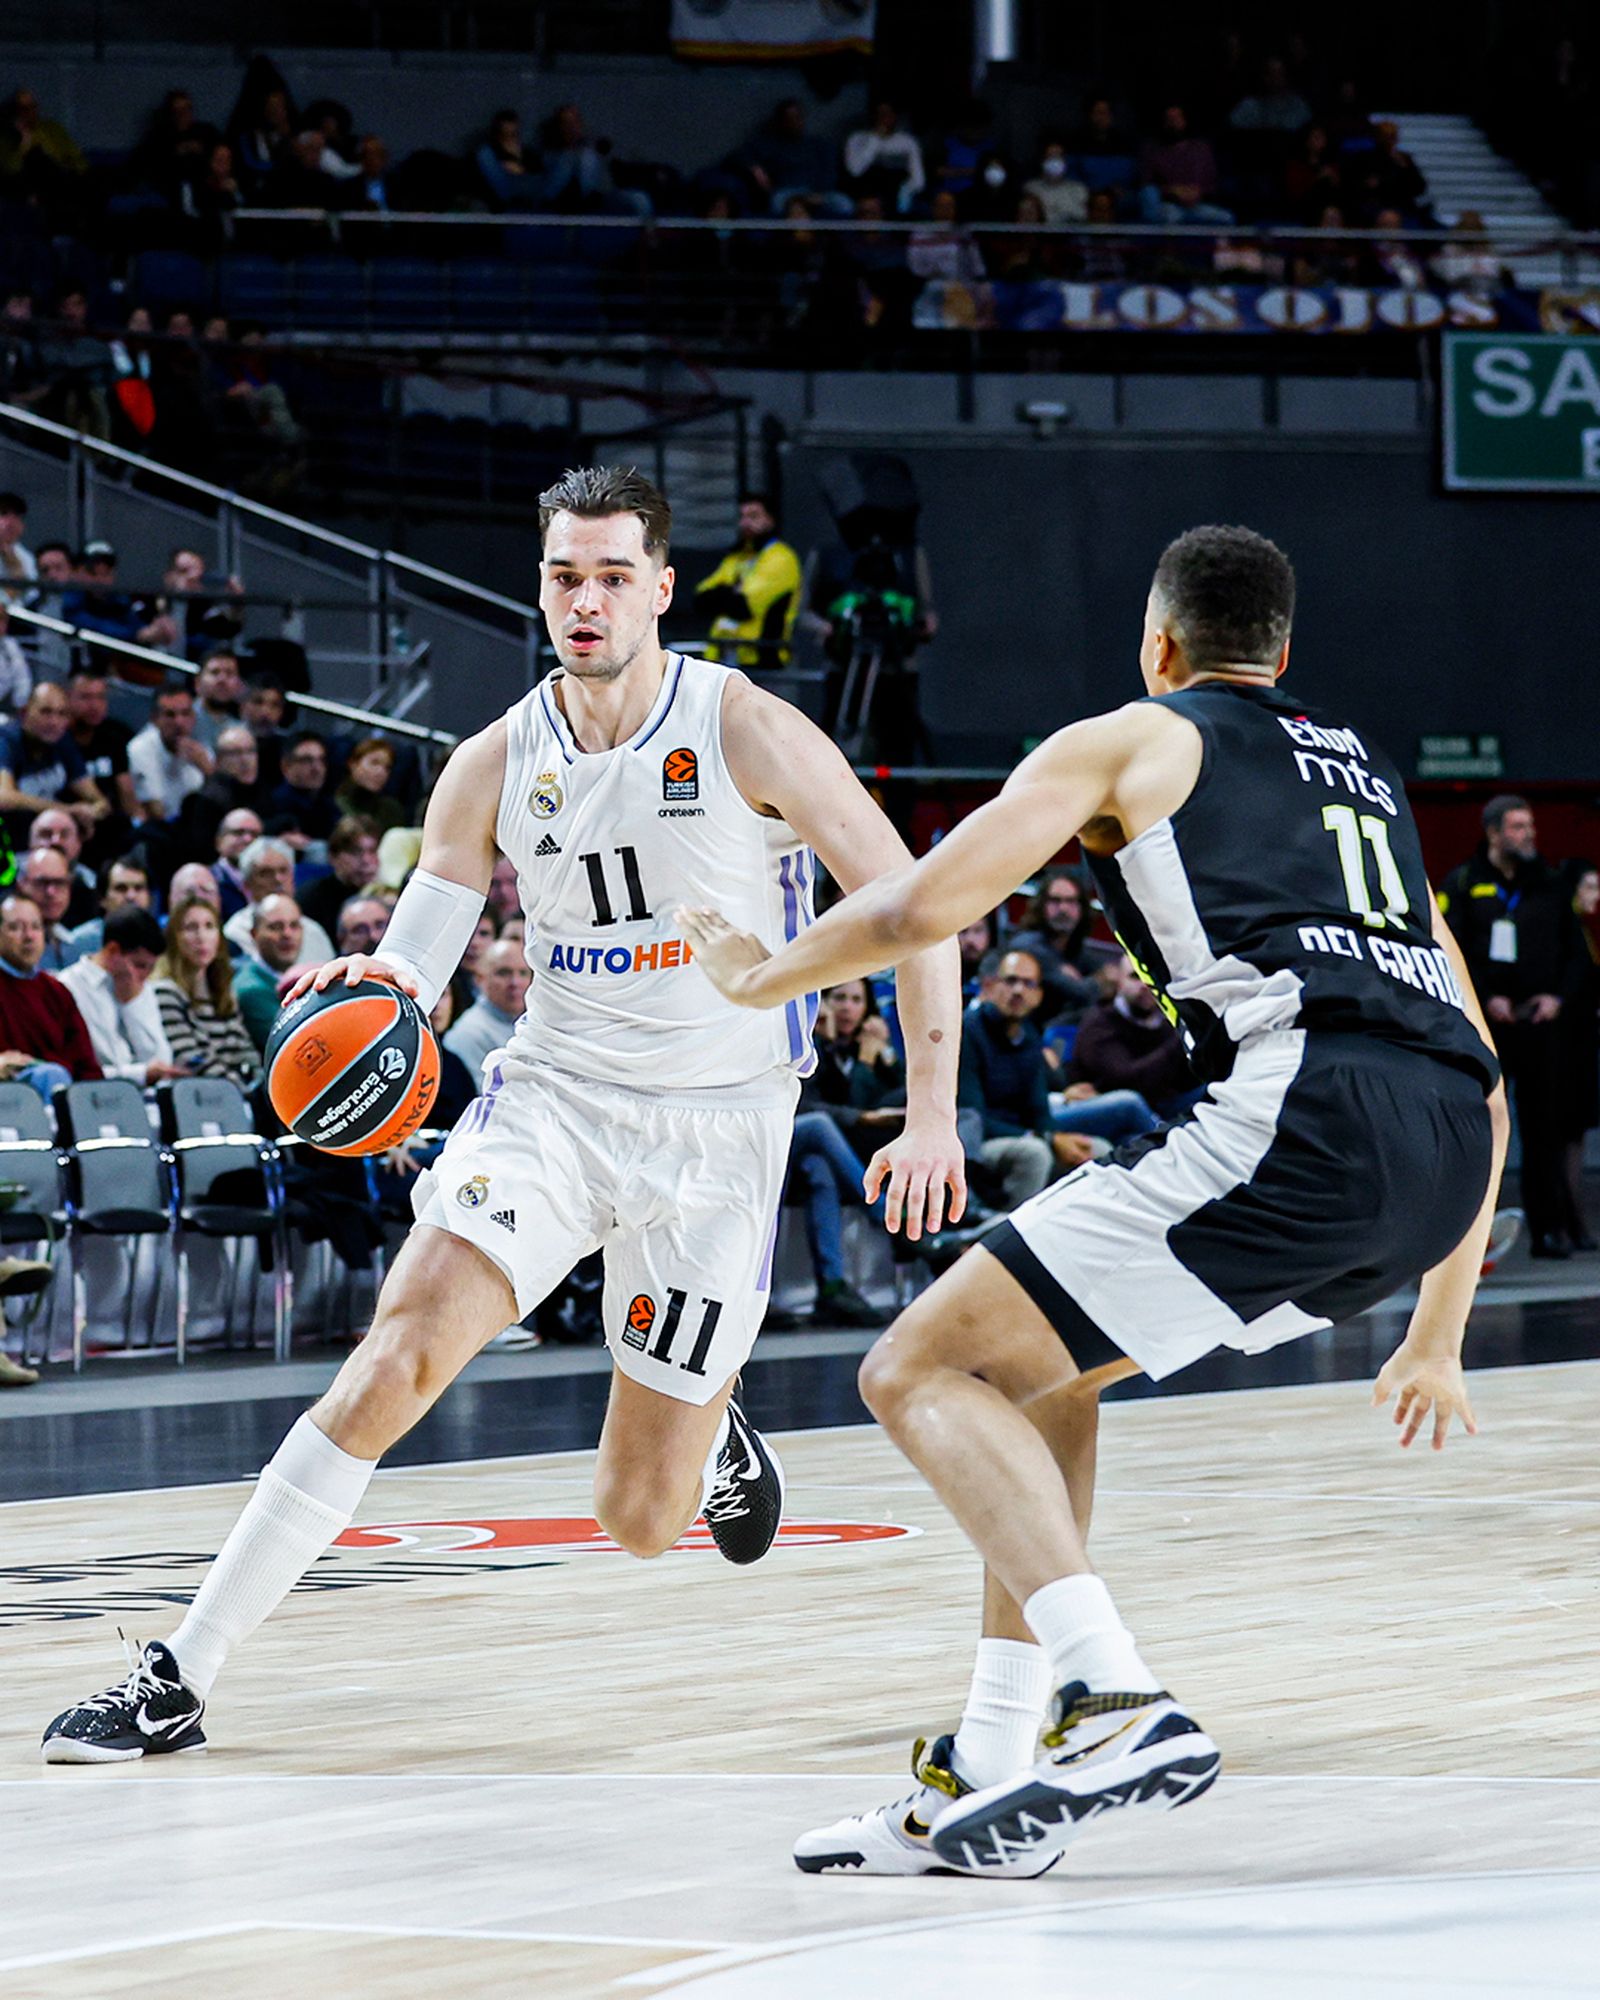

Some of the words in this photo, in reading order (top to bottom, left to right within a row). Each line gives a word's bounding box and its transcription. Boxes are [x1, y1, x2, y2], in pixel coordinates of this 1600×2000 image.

[1061, 284, 1240, 329] LOS
[1254, 287, 1497, 333] OJOS
[1471, 347, 1600, 417] SA
[1293, 750, 1398, 816] mts
[658, 808, 705, 818] oneteam
[535, 846, 562, 857] adidas
[1321, 804, 1409, 930] 11
[578, 846, 653, 926] 11
[317, 1071, 380, 1128] EuroLeague
[346, 1082, 389, 1122] TURKISH
[490, 1213, 516, 1234] adidas
[647, 1287, 723, 1376] 11
